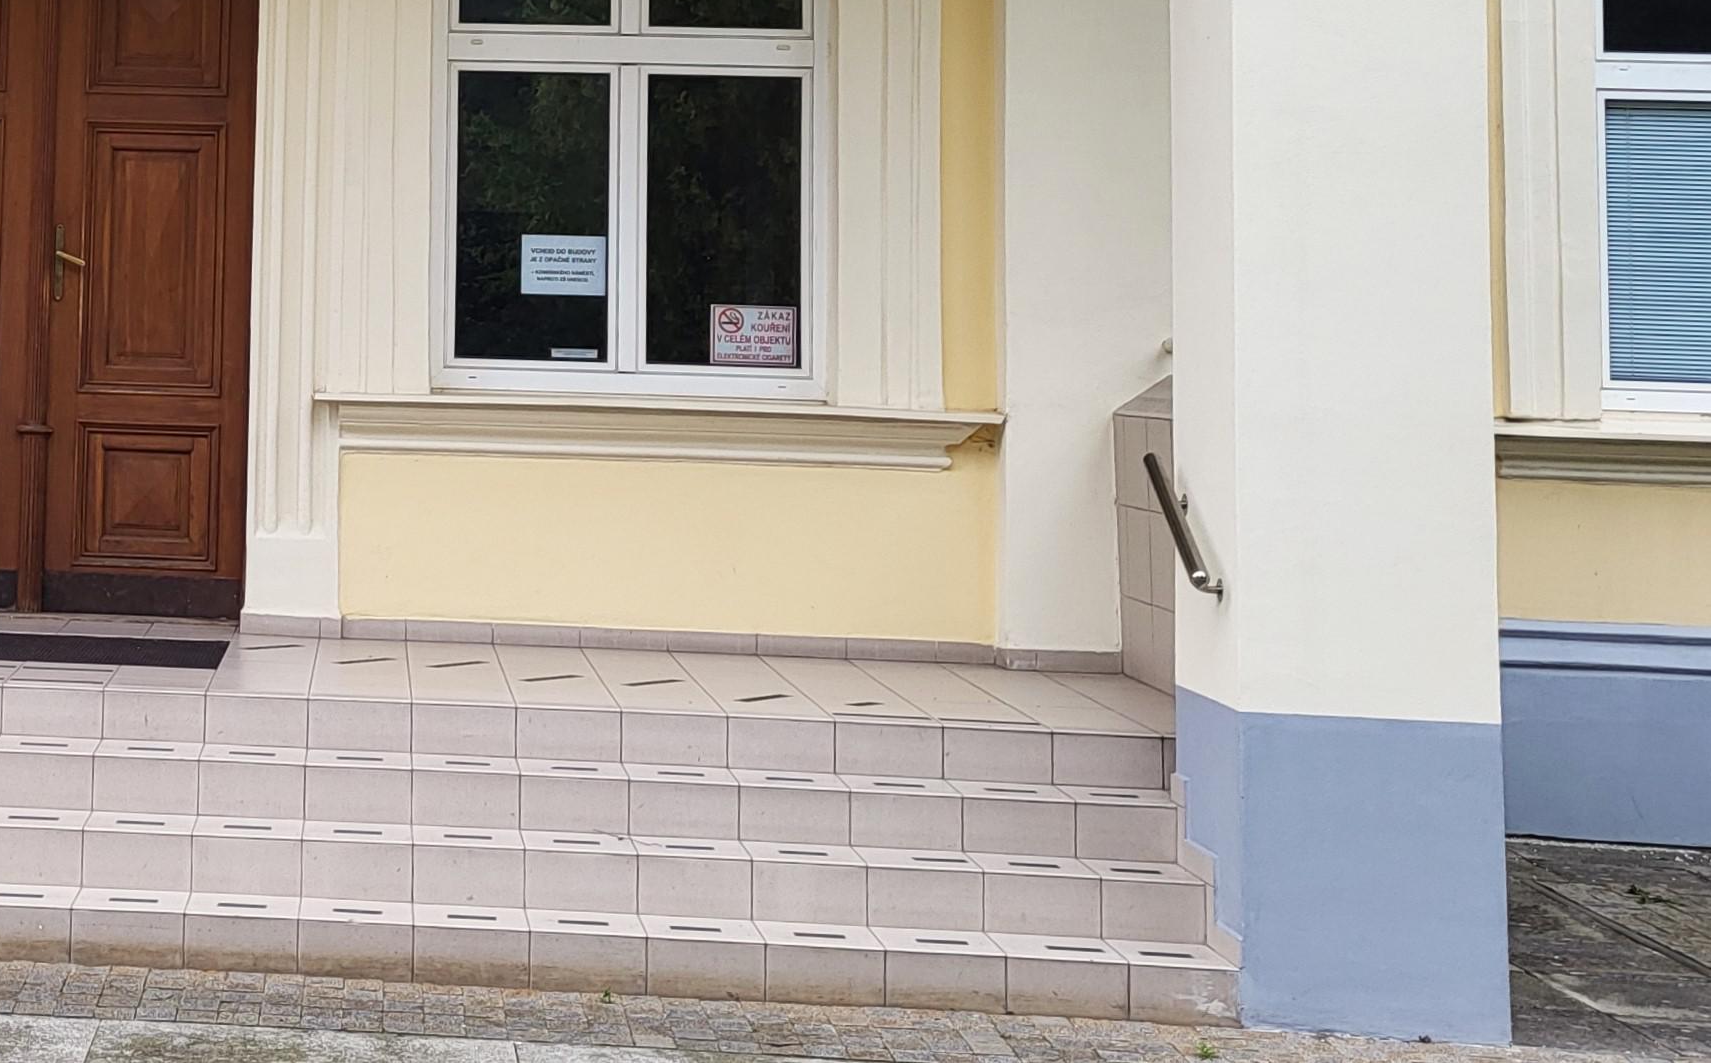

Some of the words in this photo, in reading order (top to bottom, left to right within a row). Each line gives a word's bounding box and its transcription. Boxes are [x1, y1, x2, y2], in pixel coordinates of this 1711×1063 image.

[757, 310, 791, 321] ZÁKAZ
[750, 322, 791, 333] KOUŘENÍ
[717, 333, 722, 343] V
[724, 333, 752, 344] CELÉM
[753, 335, 791, 346] OBJEKTU
